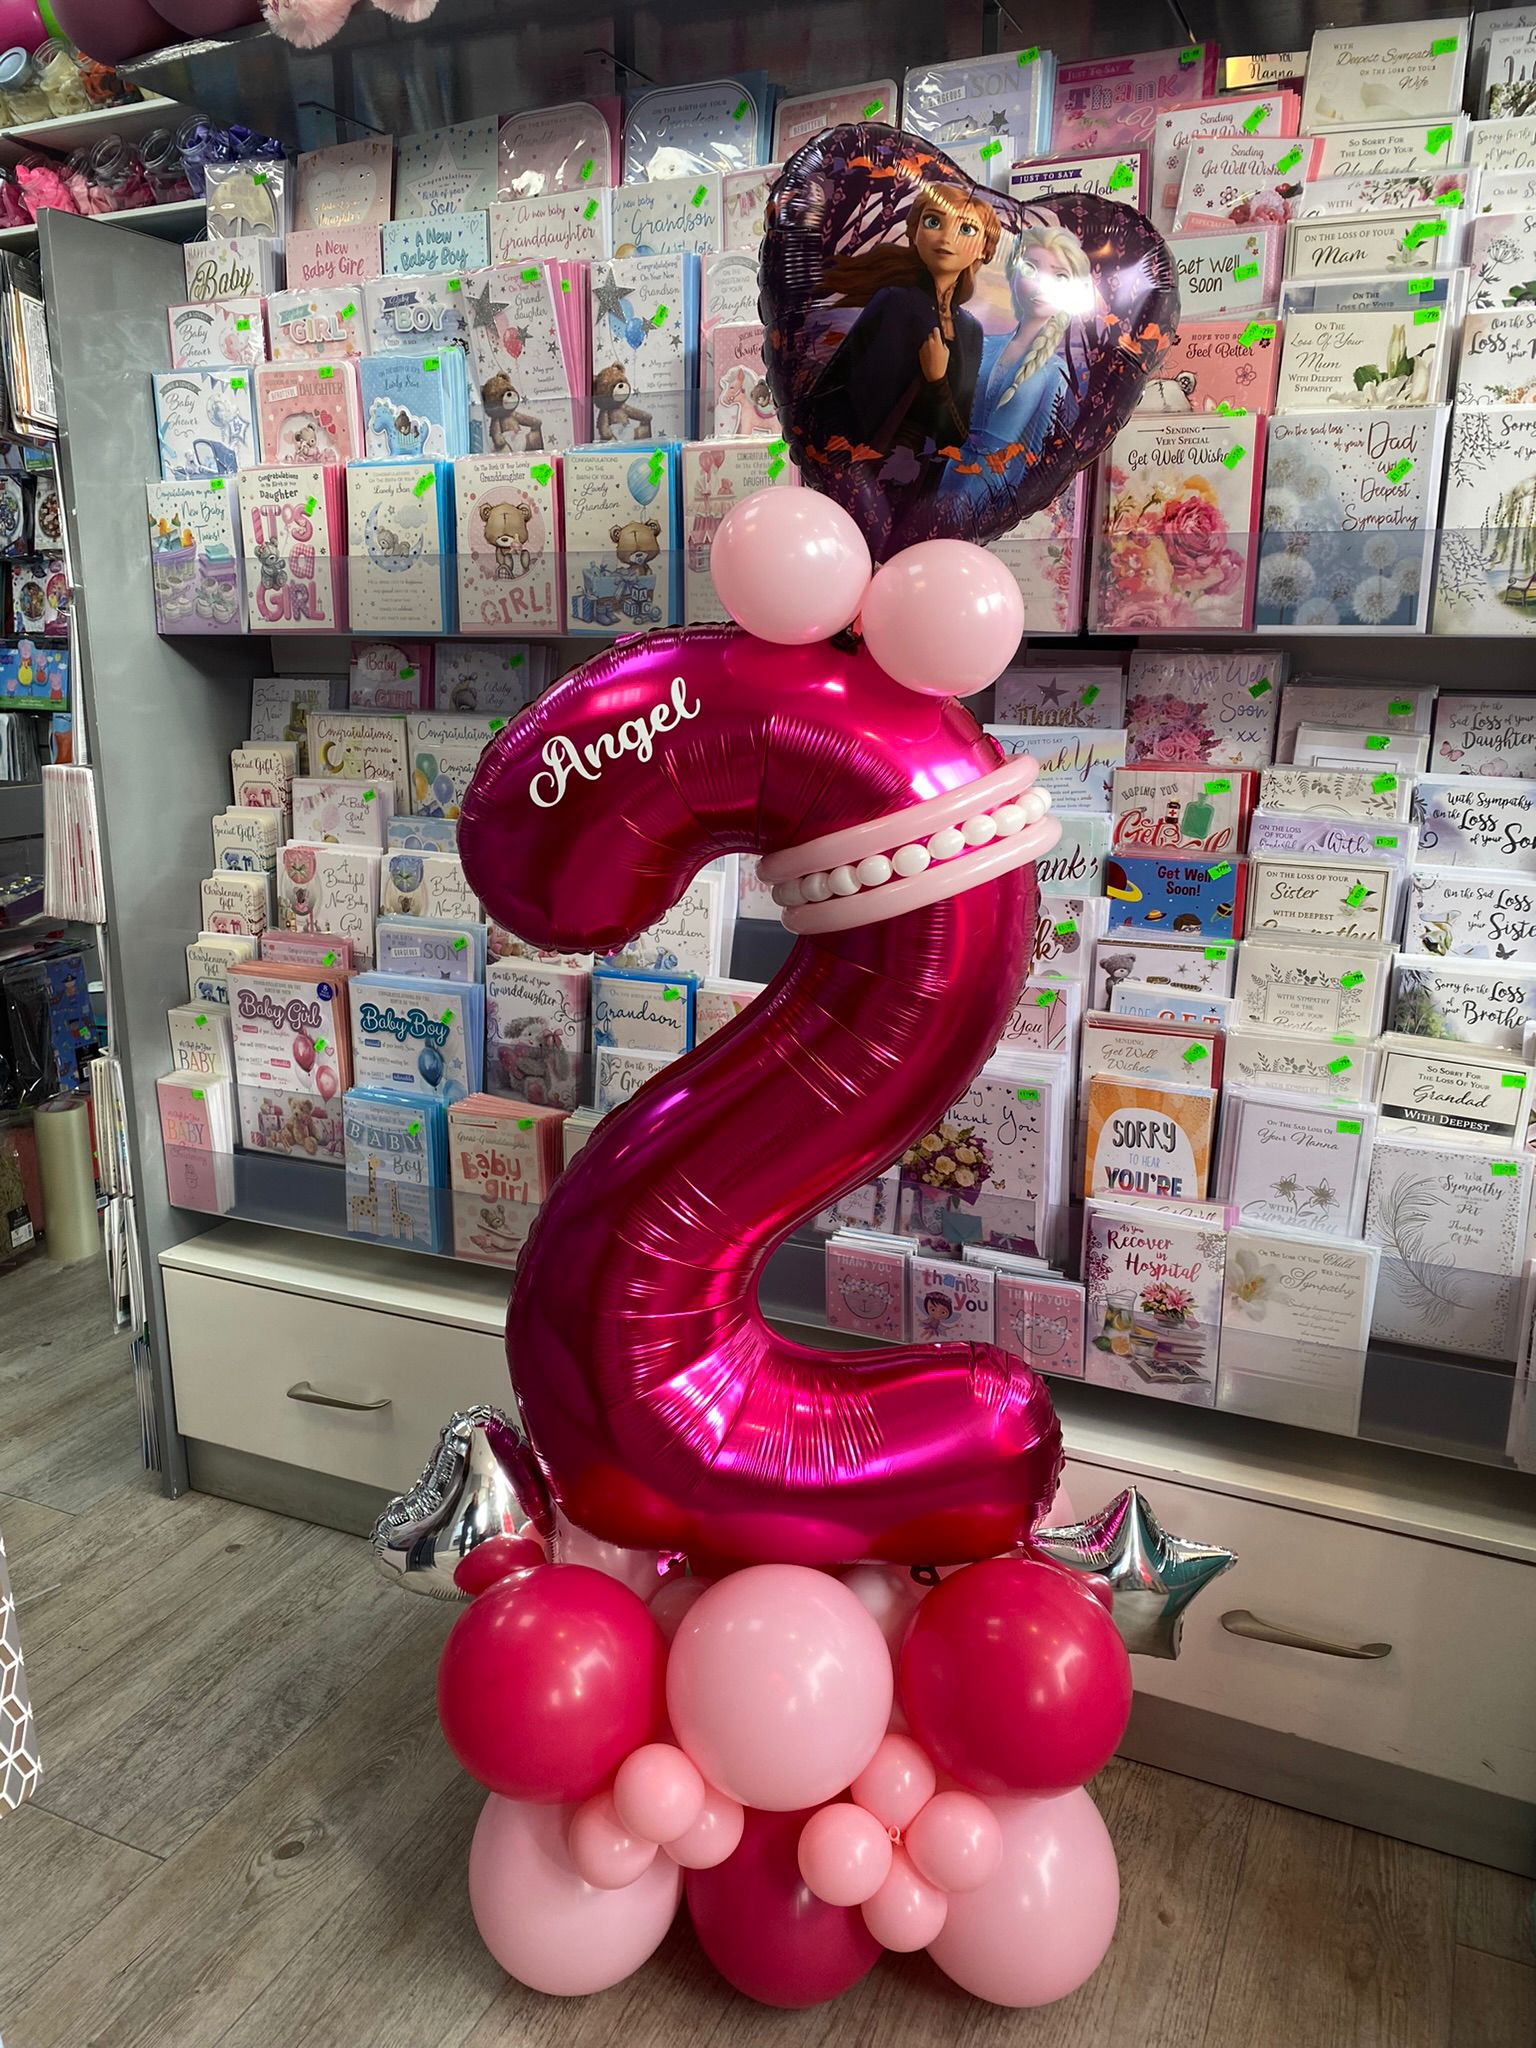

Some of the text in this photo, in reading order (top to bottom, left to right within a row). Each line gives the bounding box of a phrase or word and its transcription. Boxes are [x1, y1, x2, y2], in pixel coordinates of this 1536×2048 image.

[1333, 42, 1354, 50] WITH
[1248, 62, 1296, 80] Nanna
[1398, 75, 1430, 90] Wife
[1200, 112, 1234, 125] Sending
[1230, 144, 1265, 159] Sending
[1019, 170, 1075, 184] JUST TO SAY
[1327, 199, 1353, 209] WITH
[631, 205, 716, 245] Grandson
[1304, 228, 1396, 243] ON THE LOSS OF YOUR
[315, 241, 349, 256] A New
[415, 230, 452, 246] A New
[499, 224, 596, 259] Granddaughter
[399, 247, 468, 272] Baby Boy
[1311, 246, 1369, 268] Mam
[188, 258, 255, 301] Baby
[302, 263, 336, 282] Baby
[514, 293, 545, 307] Grand-
[639, 283, 680, 298] Grandson
[393, 303, 447, 333] BOY
[513, 306, 548, 322] daughter
[179, 322, 209, 341] Baby
[290, 314, 349, 345] GIRL
[1290, 331, 1364, 350] Loss Of Your
[1185, 341, 1255, 360] Feel Better
[1295, 351, 1342, 373] Mum
[165, 393, 196, 413] Baby
[1367, 420, 1418, 460] Dad
[259, 488, 299, 503] Daughter
[581, 482, 609, 496] Lovely
[1360, 477, 1413, 503] Deepest
[573, 498, 621, 521] Grandson
[1341, 503, 1421, 532] Sympathy
[255, 580, 326, 622] GIRL
[480, 581, 551, 627] GIRL!
[365, 651, 398, 676] Baby
[1225, 659, 1267, 687] Well
[1219, 691, 1269, 724] Soon
[316, 719, 394, 743] Congratulations
[1449, 714, 1470, 729] Sad
[1470, 711, 1503, 732] Loss
[1504, 715, 1514, 725] of
[529, 676, 701, 808] Angel
[1461, 727, 1536, 752] Daughter
[1121, 783, 1180, 801] HOPING YOU
[1446, 791, 1534, 812] With Sympathy
[1258, 823, 1302, 834] ON THE LOSS
[1432, 807, 1500, 832] On the Loss
[1274, 832, 1294, 840] YOUR
[339, 859, 350, 874] A
[1157, 865, 1212, 883] Get Well
[1279, 871, 1295, 879] THE
[1329, 875, 1349, 883] YOUR
[1166, 880, 1201, 897] Soon!
[1270, 881, 1320, 901] Sister
[1443, 886, 1534, 912] On the Sad Loss
[218, 896, 236, 914] Gift
[1272, 909, 1334, 920] WITH DEEPEST
[489, 981, 557, 1007] Granddaughter
[1434, 977, 1461, 993] Sorry
[1462, 983, 1475, 994] for
[1487, 981, 1527, 1004] Loss
[238, 992, 322, 1031] Baby Girl
[595, 1000, 682, 1032] Grandson
[361, 1004, 450, 1046] Baby Boy
[1101, 1042, 1160, 1060] Get Well
[1114, 1037, 1145, 1047] SENDING
[176, 1047, 218, 1074] BABY
[1107, 1058, 1152, 1074] Wishes
[1412, 1084, 1492, 1109] Grandad
[165, 1117, 206, 1146] BABY
[349, 1117, 420, 1151] BABY
[1112, 1118, 1177, 1153] SORRY
[1257, 1127, 1340, 1152] Your Nanna
[392, 1152, 425, 1183] Boy
[1128, 1152, 1162, 1168] TO HEAR
[1104, 1165, 1183, 1197] YOU'RE
[1441, 1173, 1506, 1200] Sympathy
[1268, 1201, 1294, 1214] WITH
[1106, 1228, 1174, 1250] Recover
[1125, 1252, 1202, 1283] Hospital
[1156, 1252, 1168, 1261] in
[922, 1268, 981, 1294] thank
[1279, 1266, 1357, 1300] Sympathy
